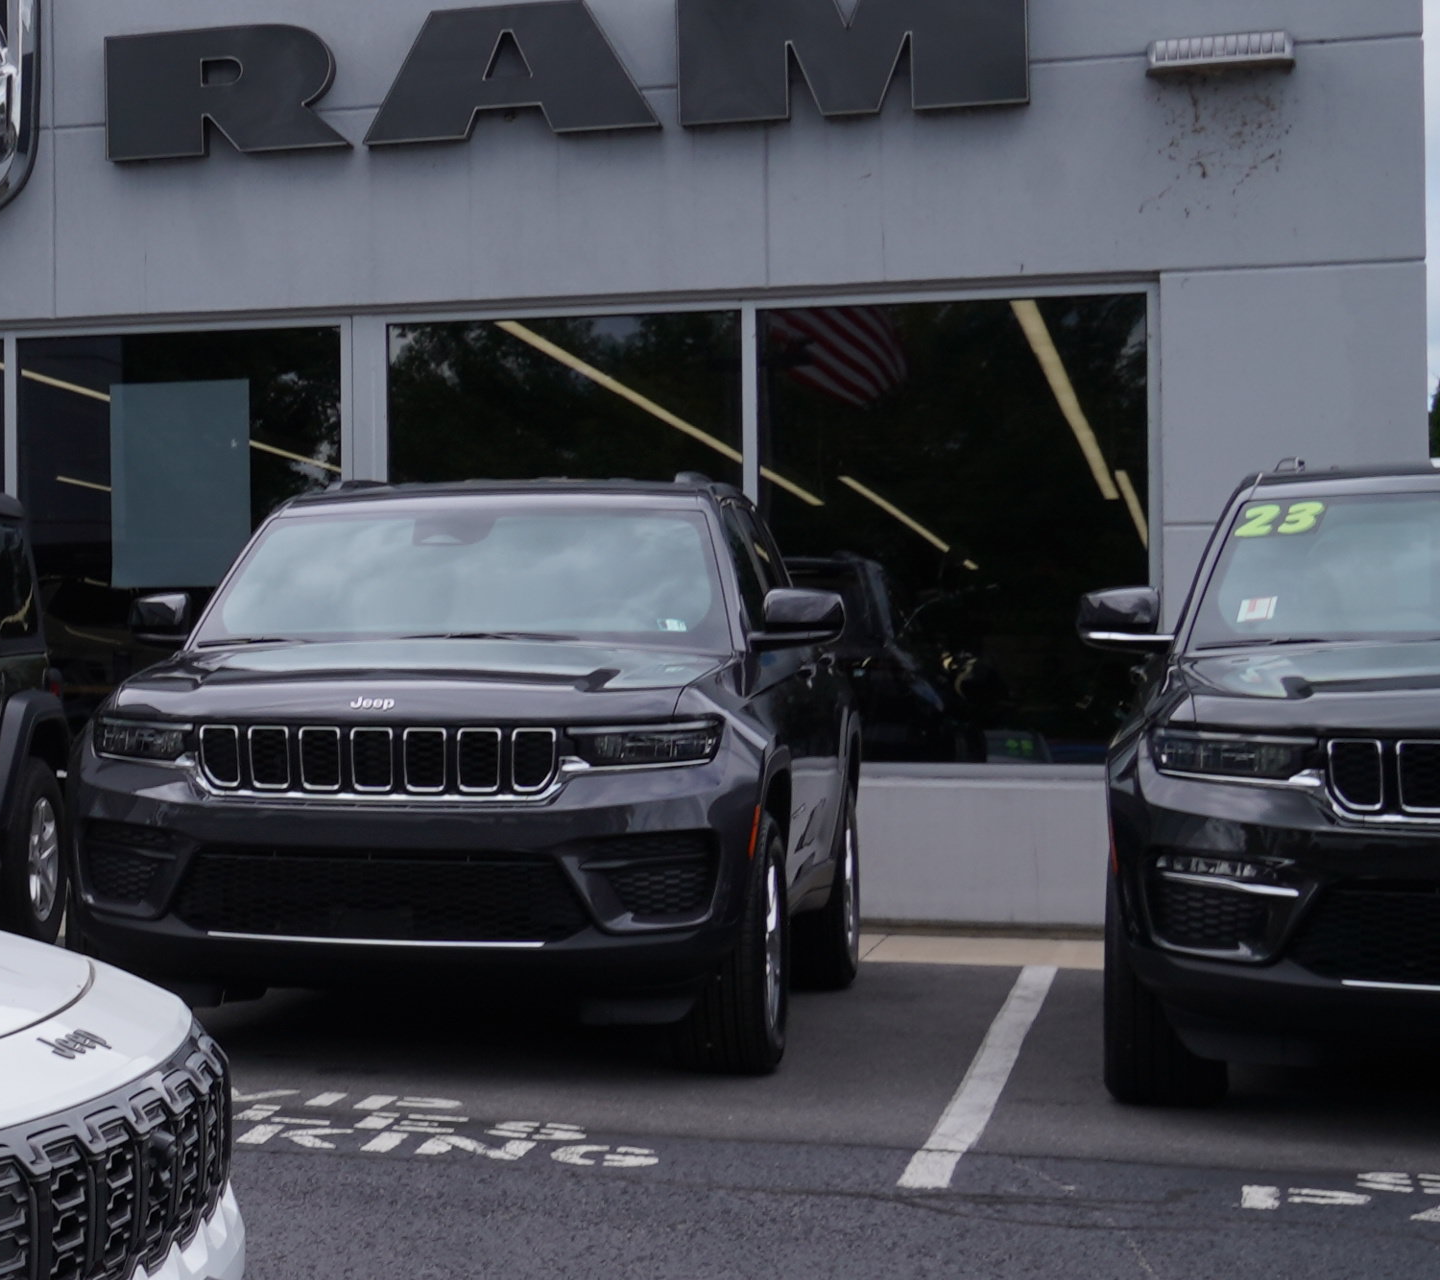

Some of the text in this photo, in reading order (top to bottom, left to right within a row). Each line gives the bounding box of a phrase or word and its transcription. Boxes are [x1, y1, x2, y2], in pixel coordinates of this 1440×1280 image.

[1234, 501, 1325, 538] 23
[36, 1028, 112, 1060] Jeep
[235, 1123, 660, 1167] KING
